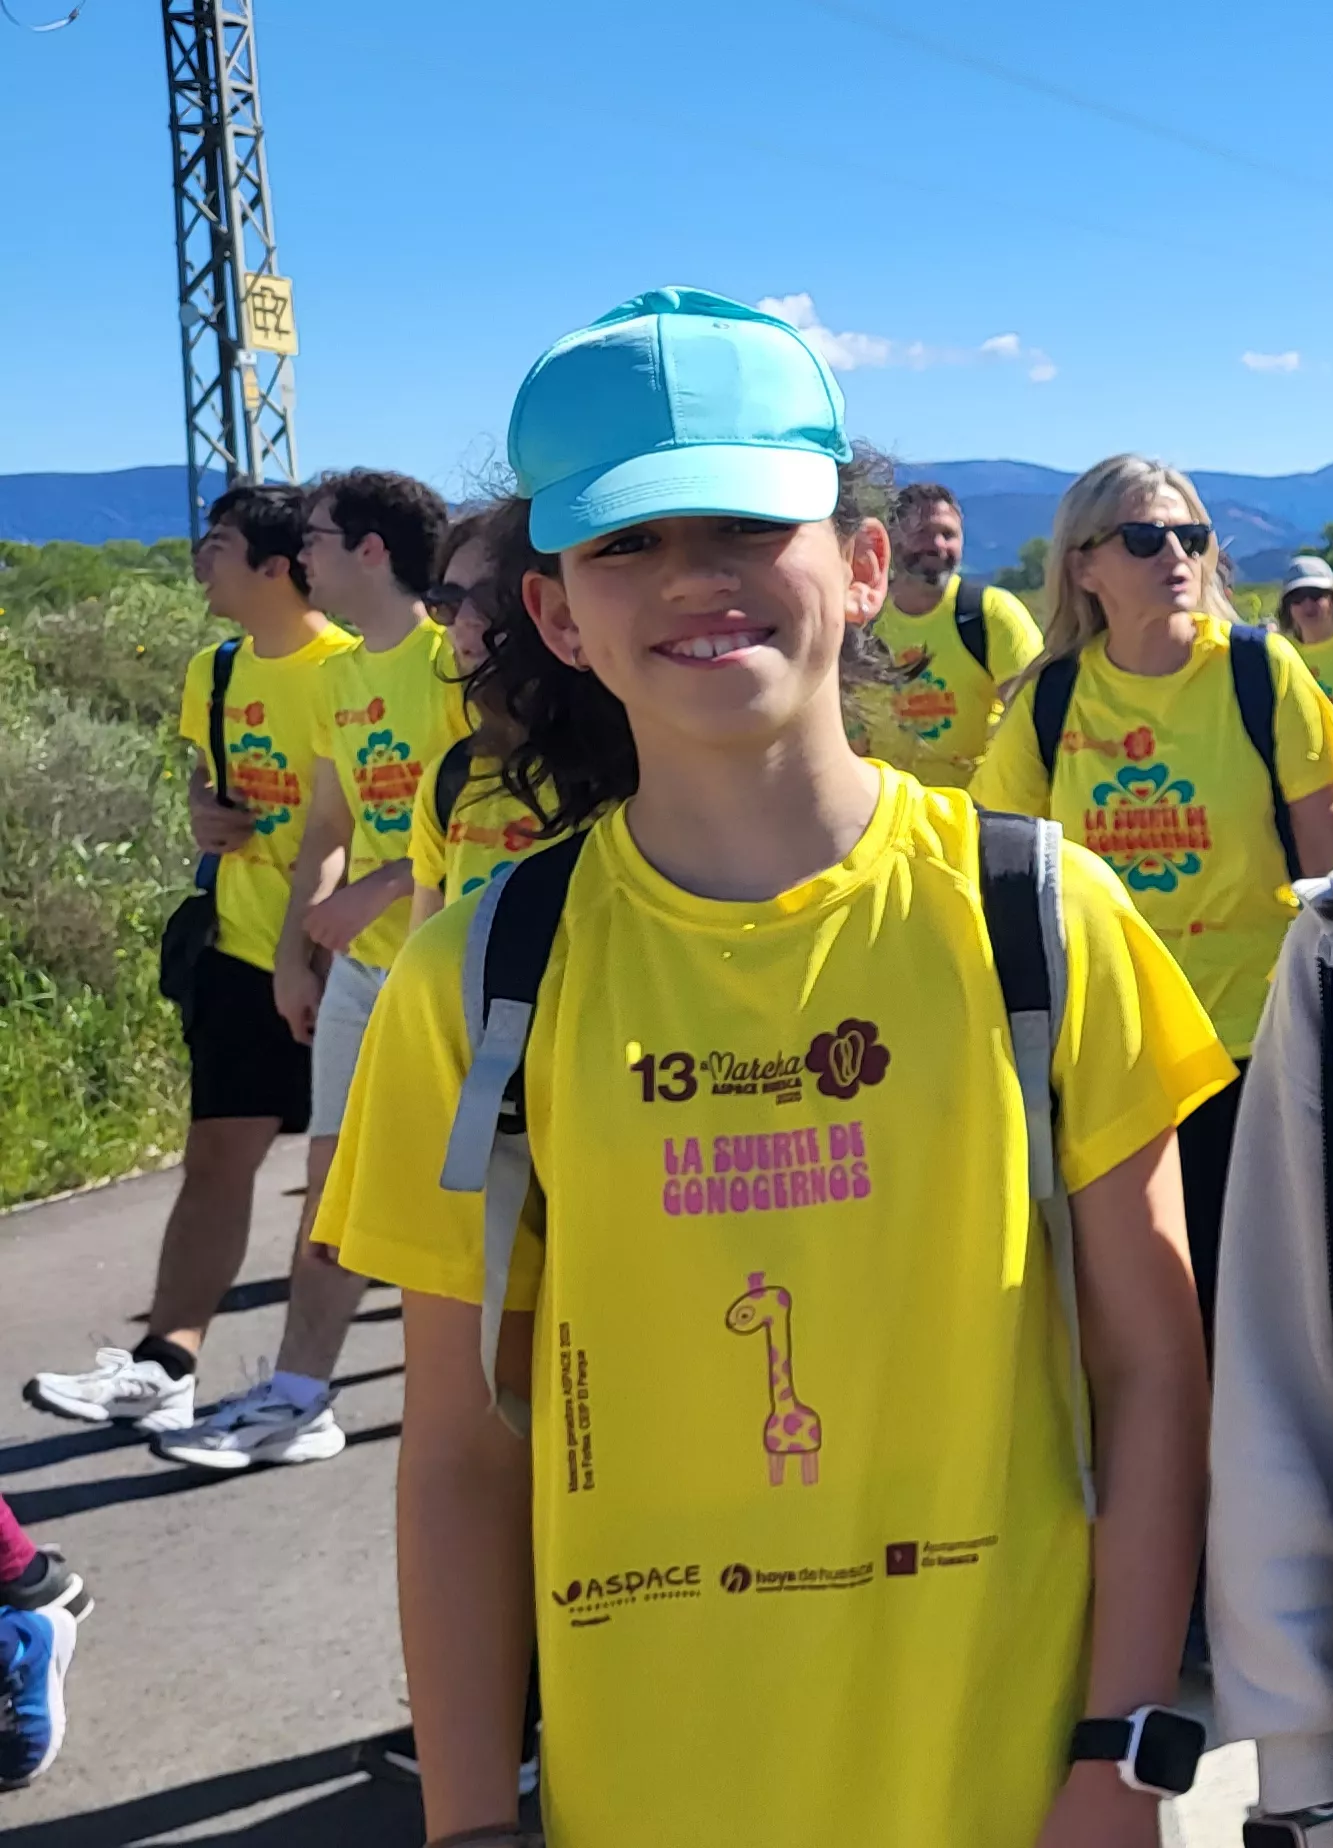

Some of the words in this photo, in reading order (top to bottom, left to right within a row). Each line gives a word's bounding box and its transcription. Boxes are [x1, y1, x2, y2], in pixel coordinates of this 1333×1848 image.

[709, 1049, 804, 1082] Marcha
[663, 1137, 703, 1175] LA
[712, 1127, 821, 1173] SUERTE
[828, 1120, 866, 1161] DE
[586, 1564, 701, 1600] ASPACE
